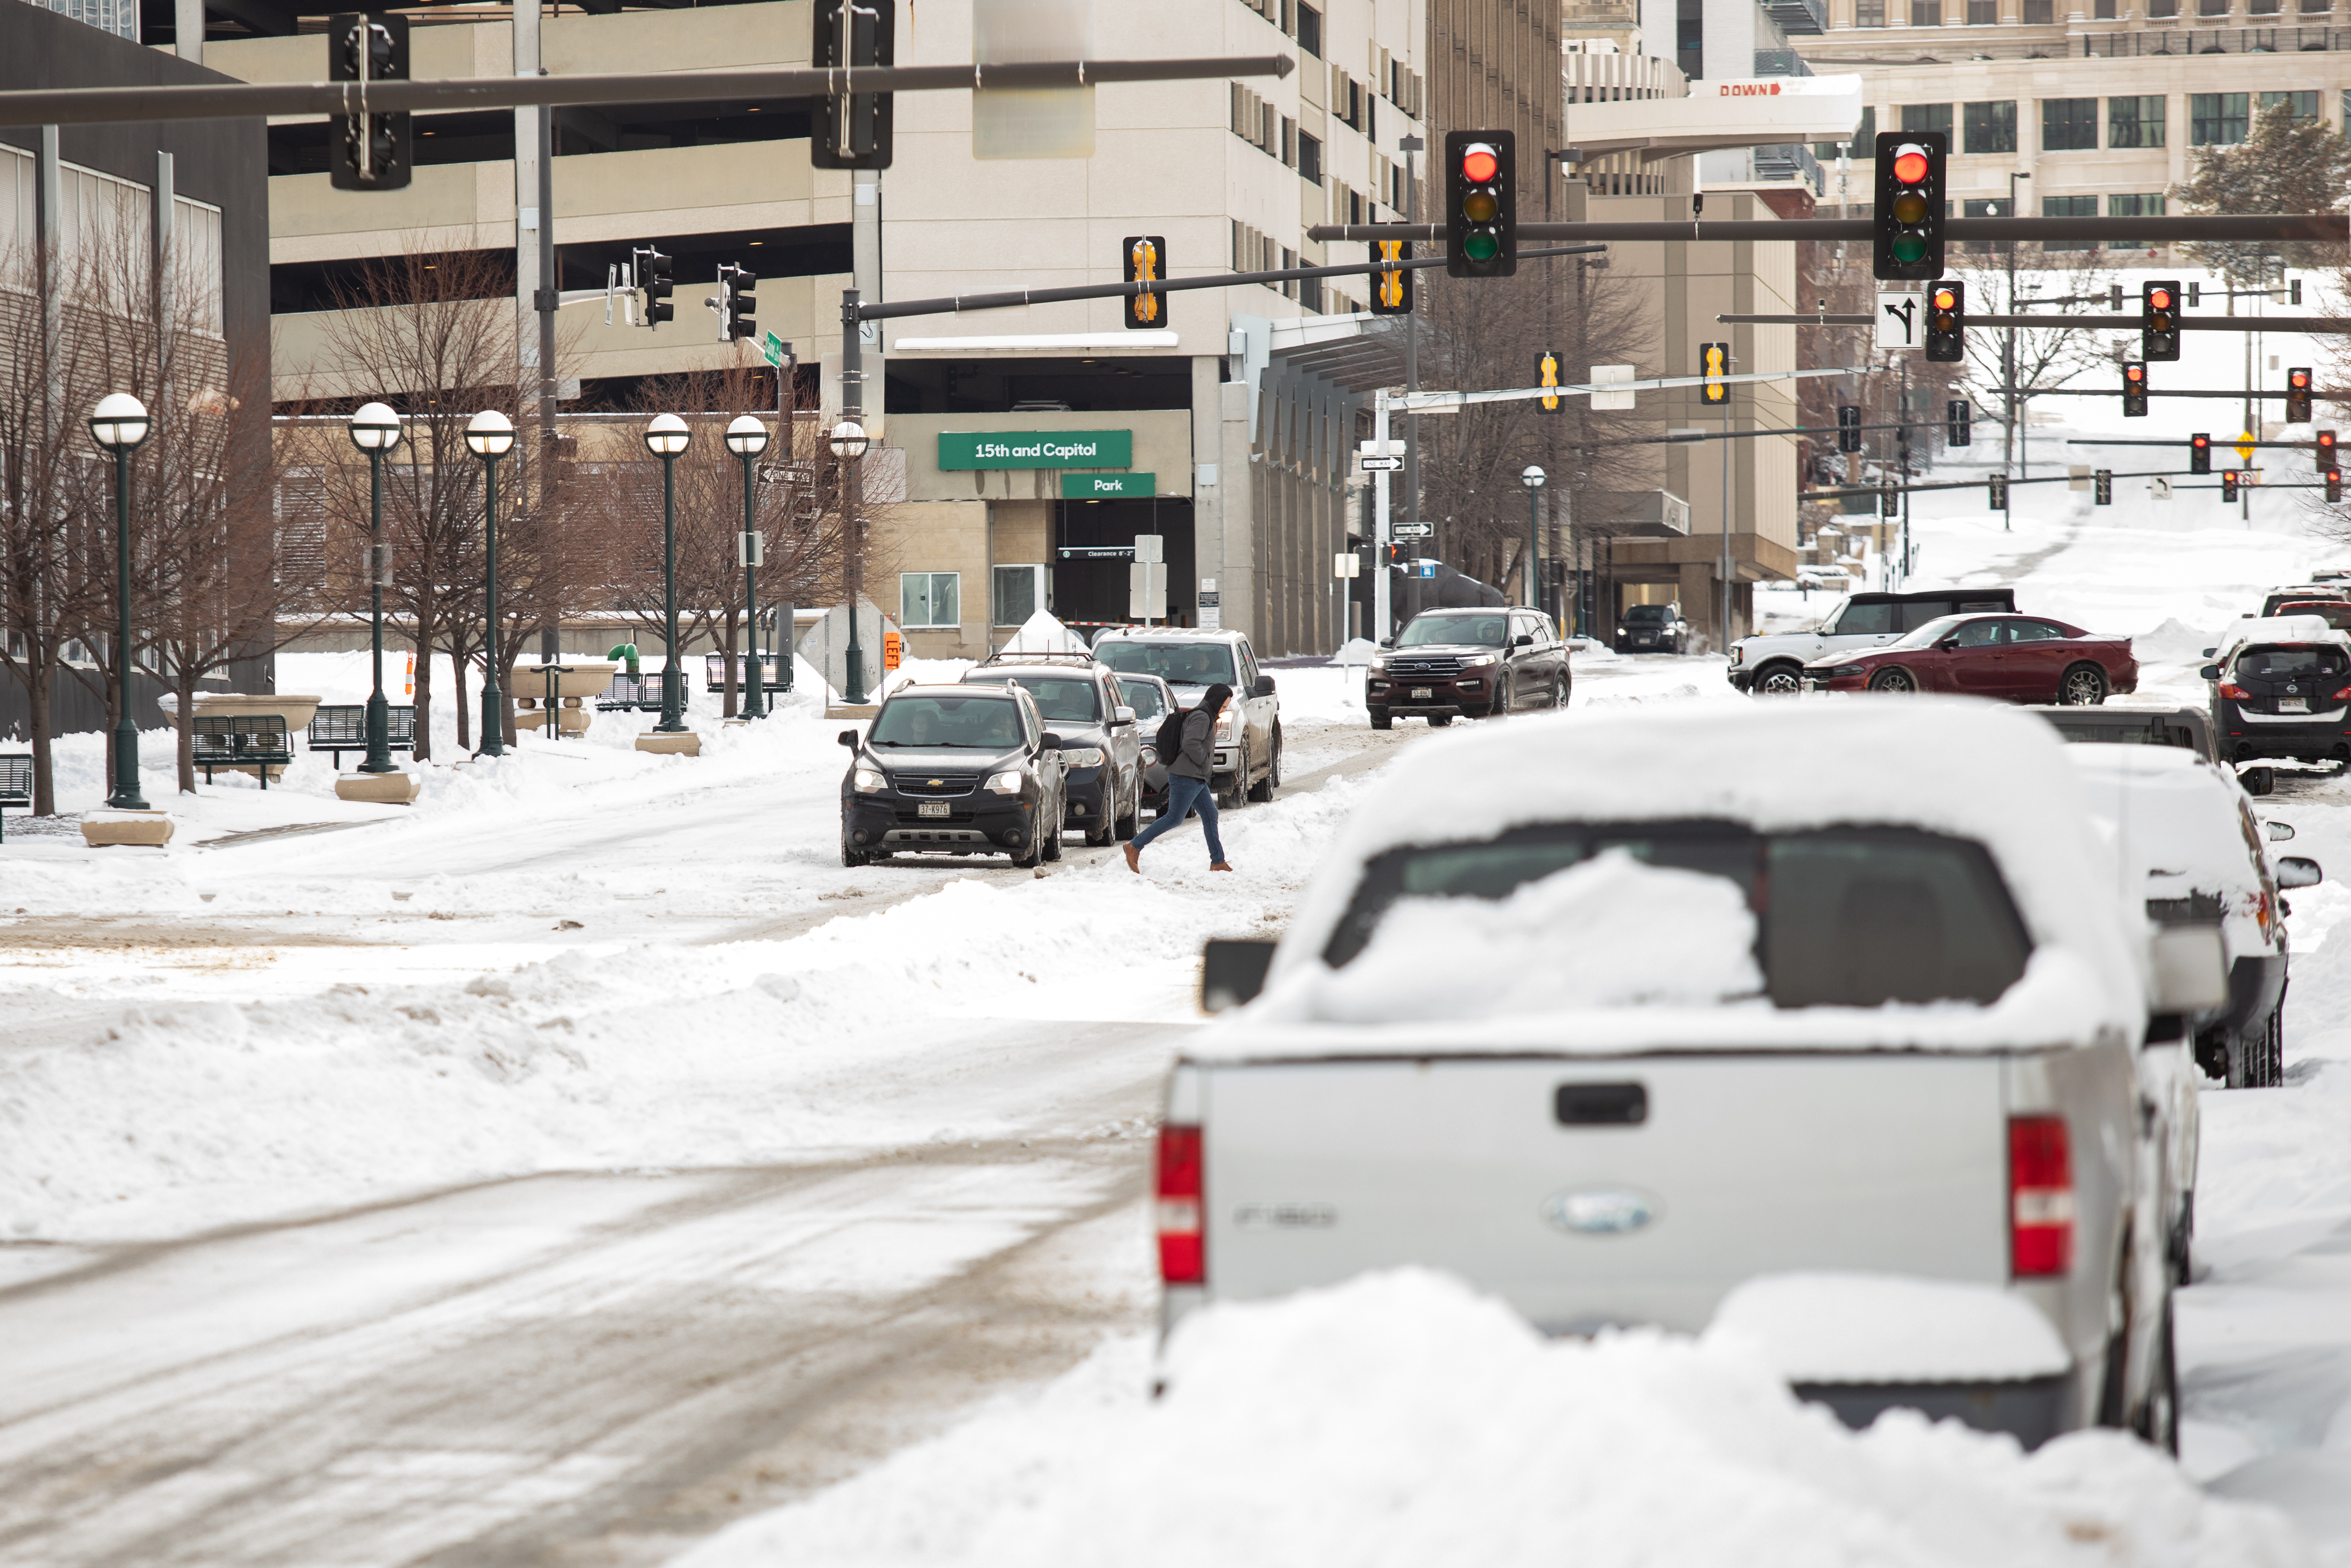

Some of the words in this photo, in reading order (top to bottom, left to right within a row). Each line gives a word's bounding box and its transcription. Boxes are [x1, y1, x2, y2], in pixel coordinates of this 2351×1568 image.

[1720, 85, 1767, 96] DOWN
[975, 444, 1009, 458] 15th
[1012, 443, 1040, 457] and
[1042, 442, 1097, 460] Capitol
[1094, 479, 1123, 491] Park
[887, 640, 898, 668] LEFT
[921, 805, 947, 814] 37-K976
